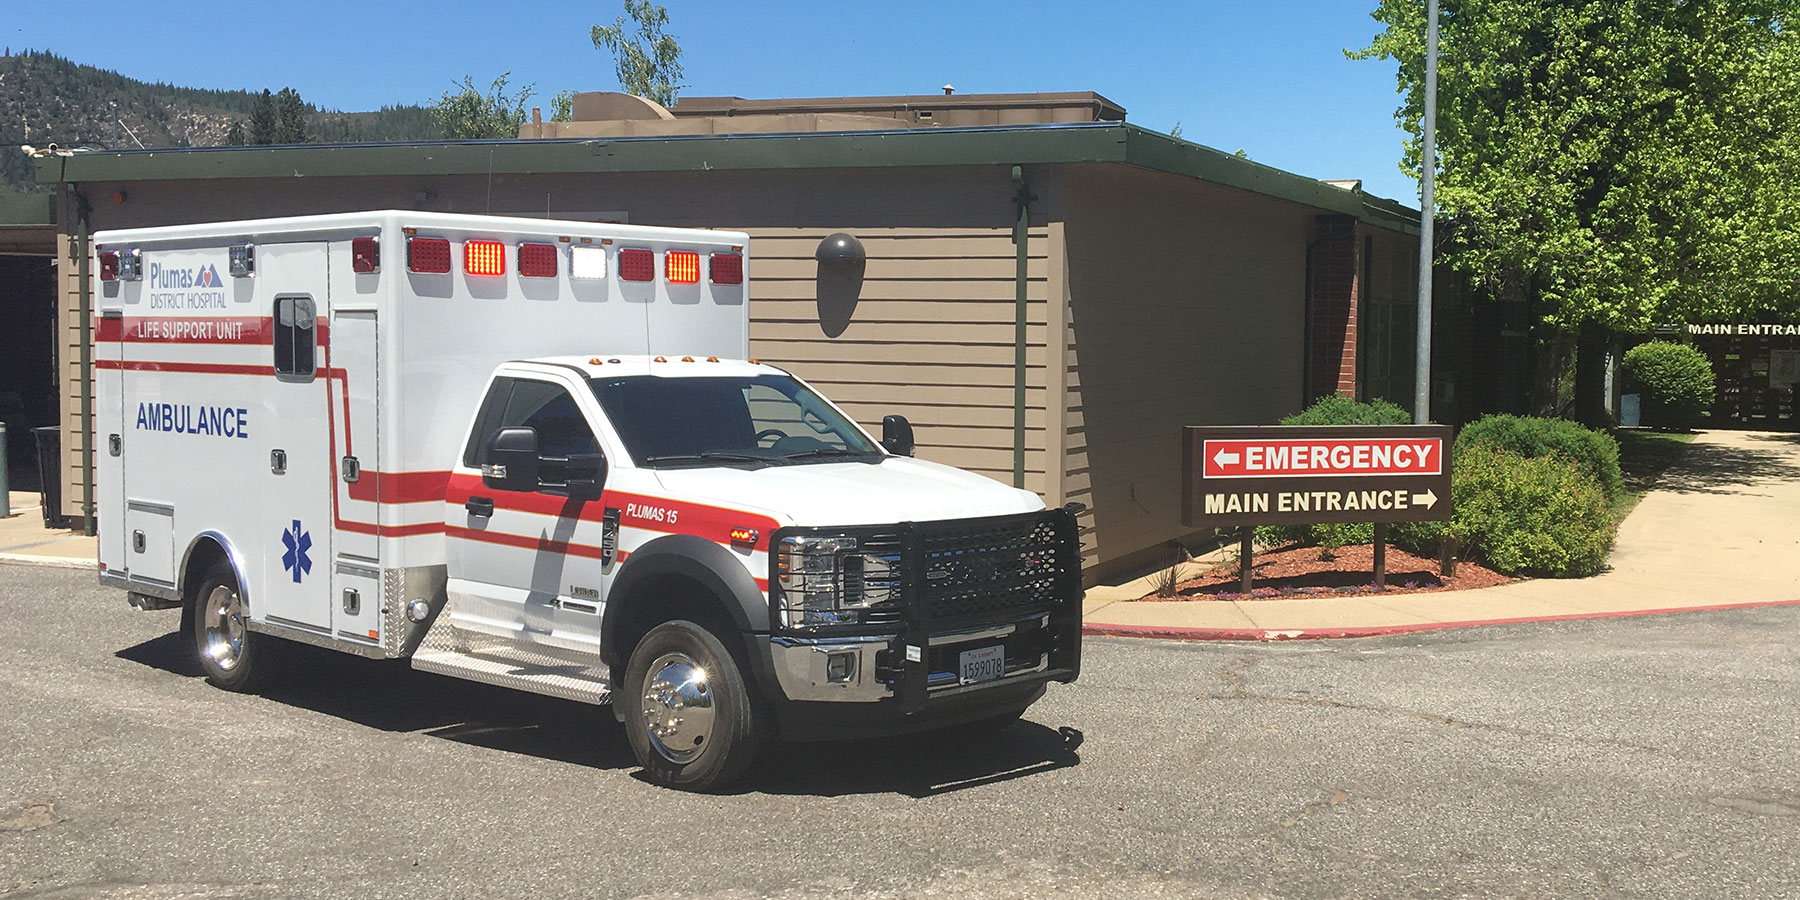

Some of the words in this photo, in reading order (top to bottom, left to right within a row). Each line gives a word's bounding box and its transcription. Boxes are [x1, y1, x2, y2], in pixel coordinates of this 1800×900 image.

[151, 263, 192, 288] Plumas
[151, 293, 185, 309] DISTRICT
[188, 292, 226, 309] HOSPITAL
[138, 321, 159, 338] LIFE
[162, 321, 213, 338] SUPPORT
[216, 321, 242, 339] UNIT
[1688, 324, 1732, 335] MAIN
[1738, 324, 1800, 335] ENTRA
[136, 402, 248, 438] AMBULANCE
[1245, 445, 1432, 470] EMERGENCY
[1205, 493, 1268, 514] MAIN
[1278, 490, 1408, 512] ENTRANCE
[626, 503, 664, 521] PLUMAS
[666, 509, 678, 524] 15
[964, 658, 1002, 680] 1599078
